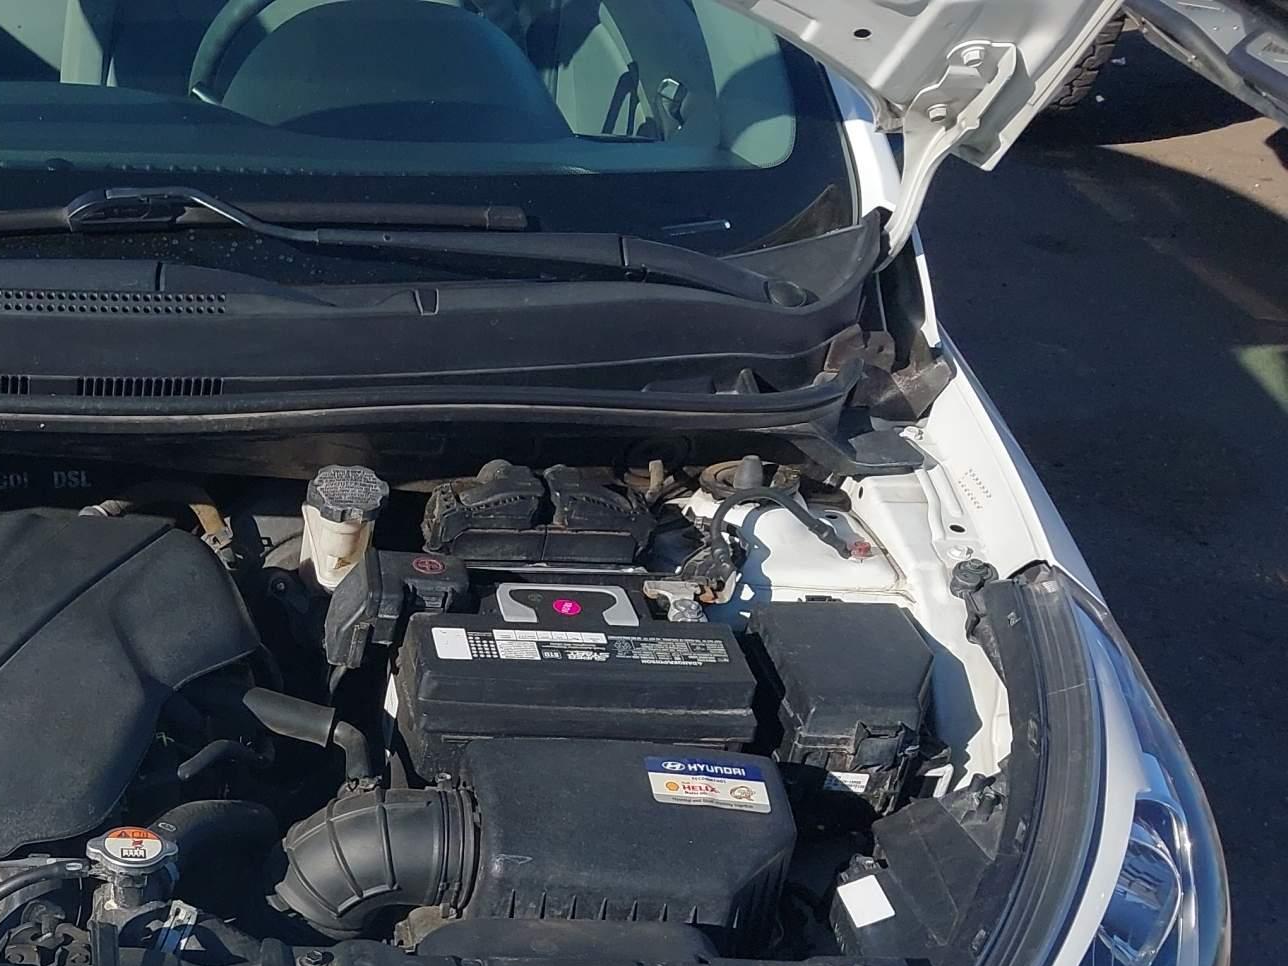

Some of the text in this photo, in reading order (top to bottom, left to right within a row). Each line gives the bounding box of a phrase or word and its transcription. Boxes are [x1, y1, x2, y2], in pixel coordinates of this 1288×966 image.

[53, 470, 92, 489] DSL
[688, 763, 746, 777] HYUNDAI
[682, 784, 720, 794] HELIX
